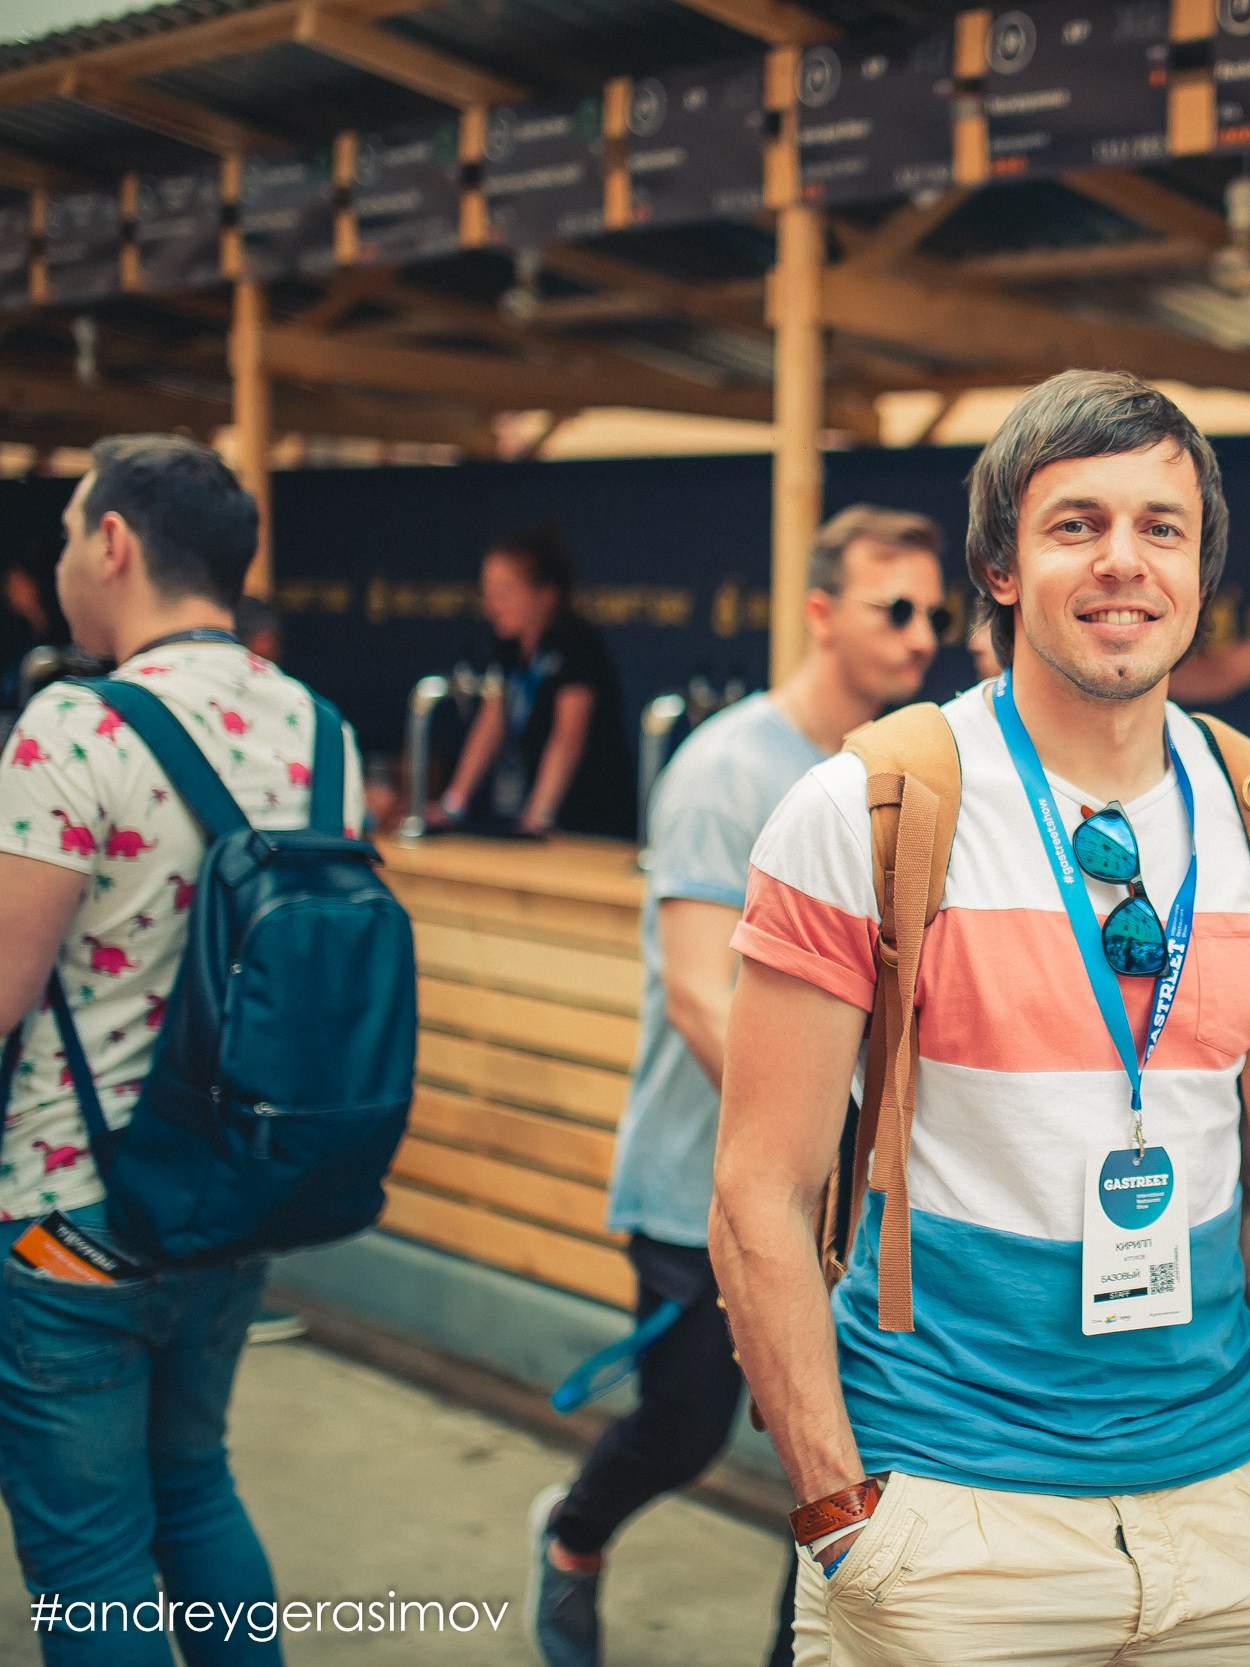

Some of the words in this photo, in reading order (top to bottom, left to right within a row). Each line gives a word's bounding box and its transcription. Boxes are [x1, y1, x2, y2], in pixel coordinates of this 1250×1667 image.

[1038, 797, 1074, 885] #gastreetshow
[1103, 1173, 1170, 1191] GASTREET
[1101, 1268, 1141, 1283] БАЗОВЫЙ
